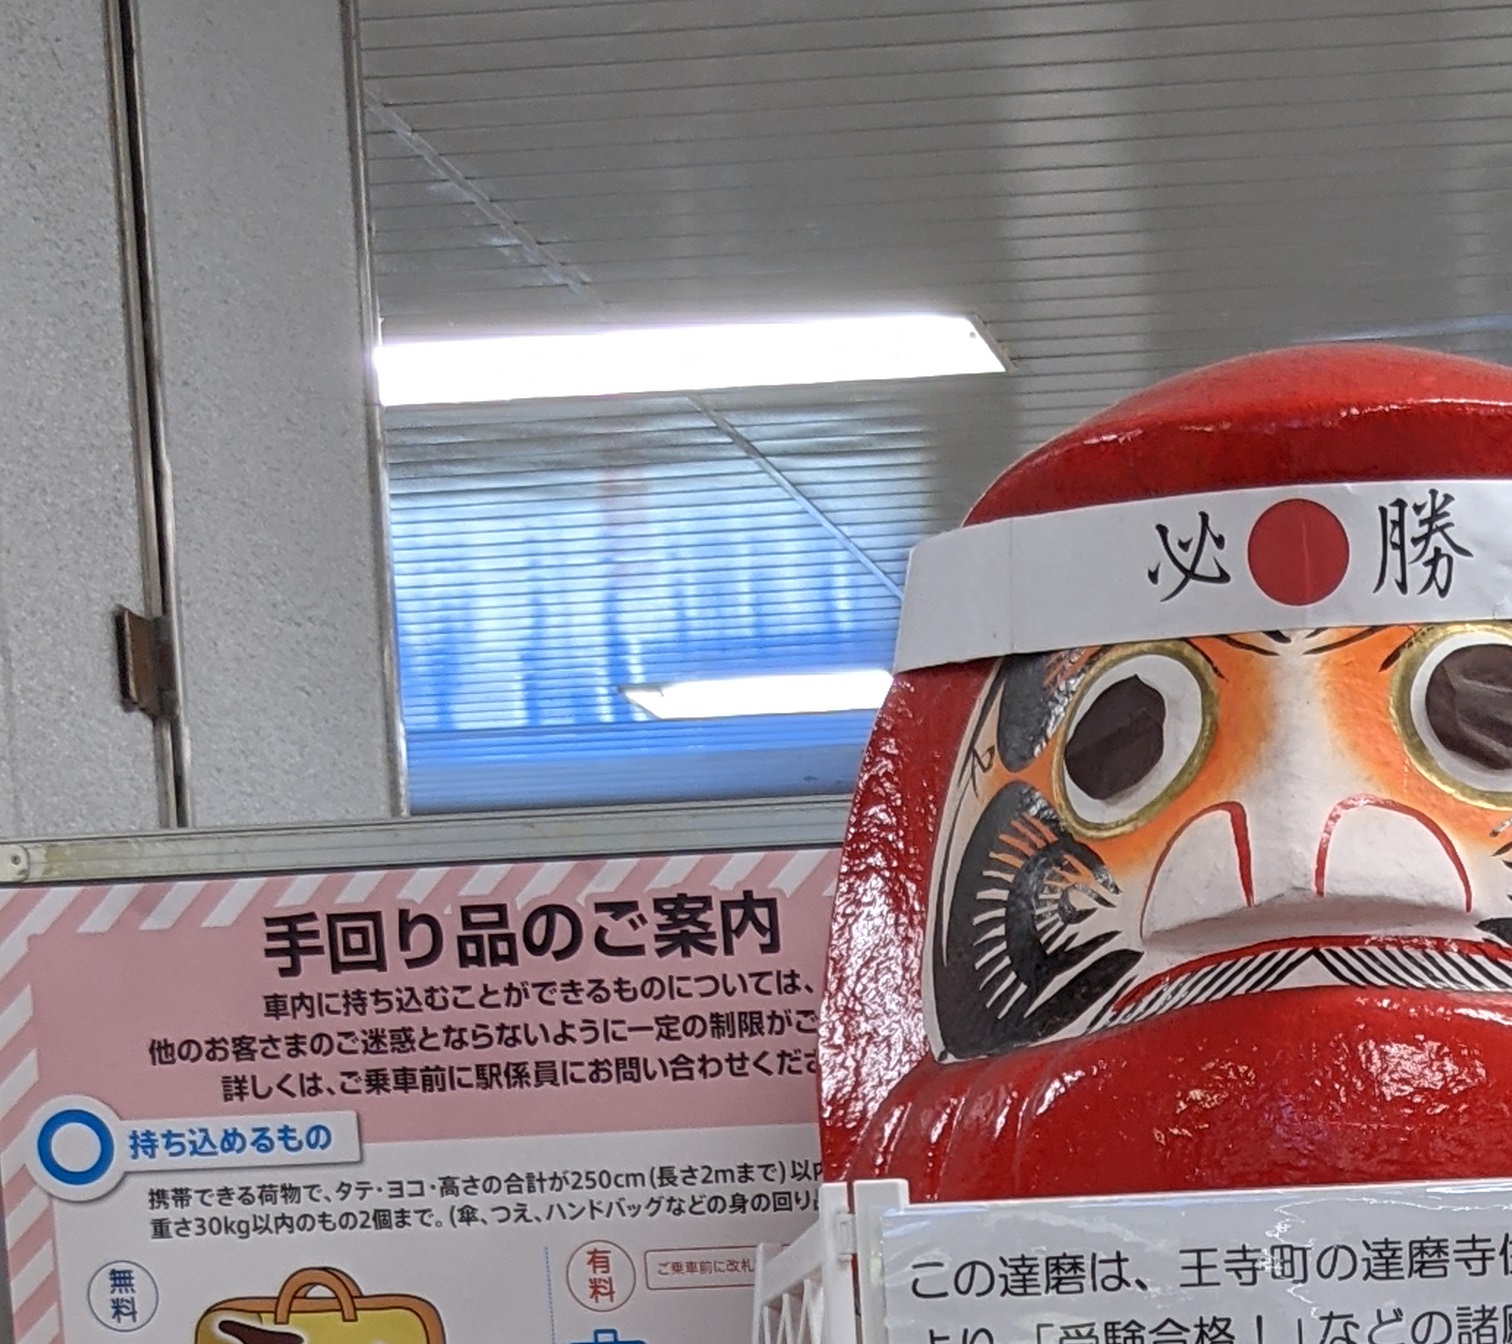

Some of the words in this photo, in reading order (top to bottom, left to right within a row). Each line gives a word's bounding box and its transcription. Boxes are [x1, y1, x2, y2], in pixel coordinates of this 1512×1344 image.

[262, 890, 782, 977] 手回り品のご案内
[263, 969, 815, 1021] 車内に持ち込むことができるものについては、
[128, 1124, 332, 1160] 持ち込めるもの
[108, 1267, 139, 1324] 無料
[586, 1247, 616, 1303] 有料
